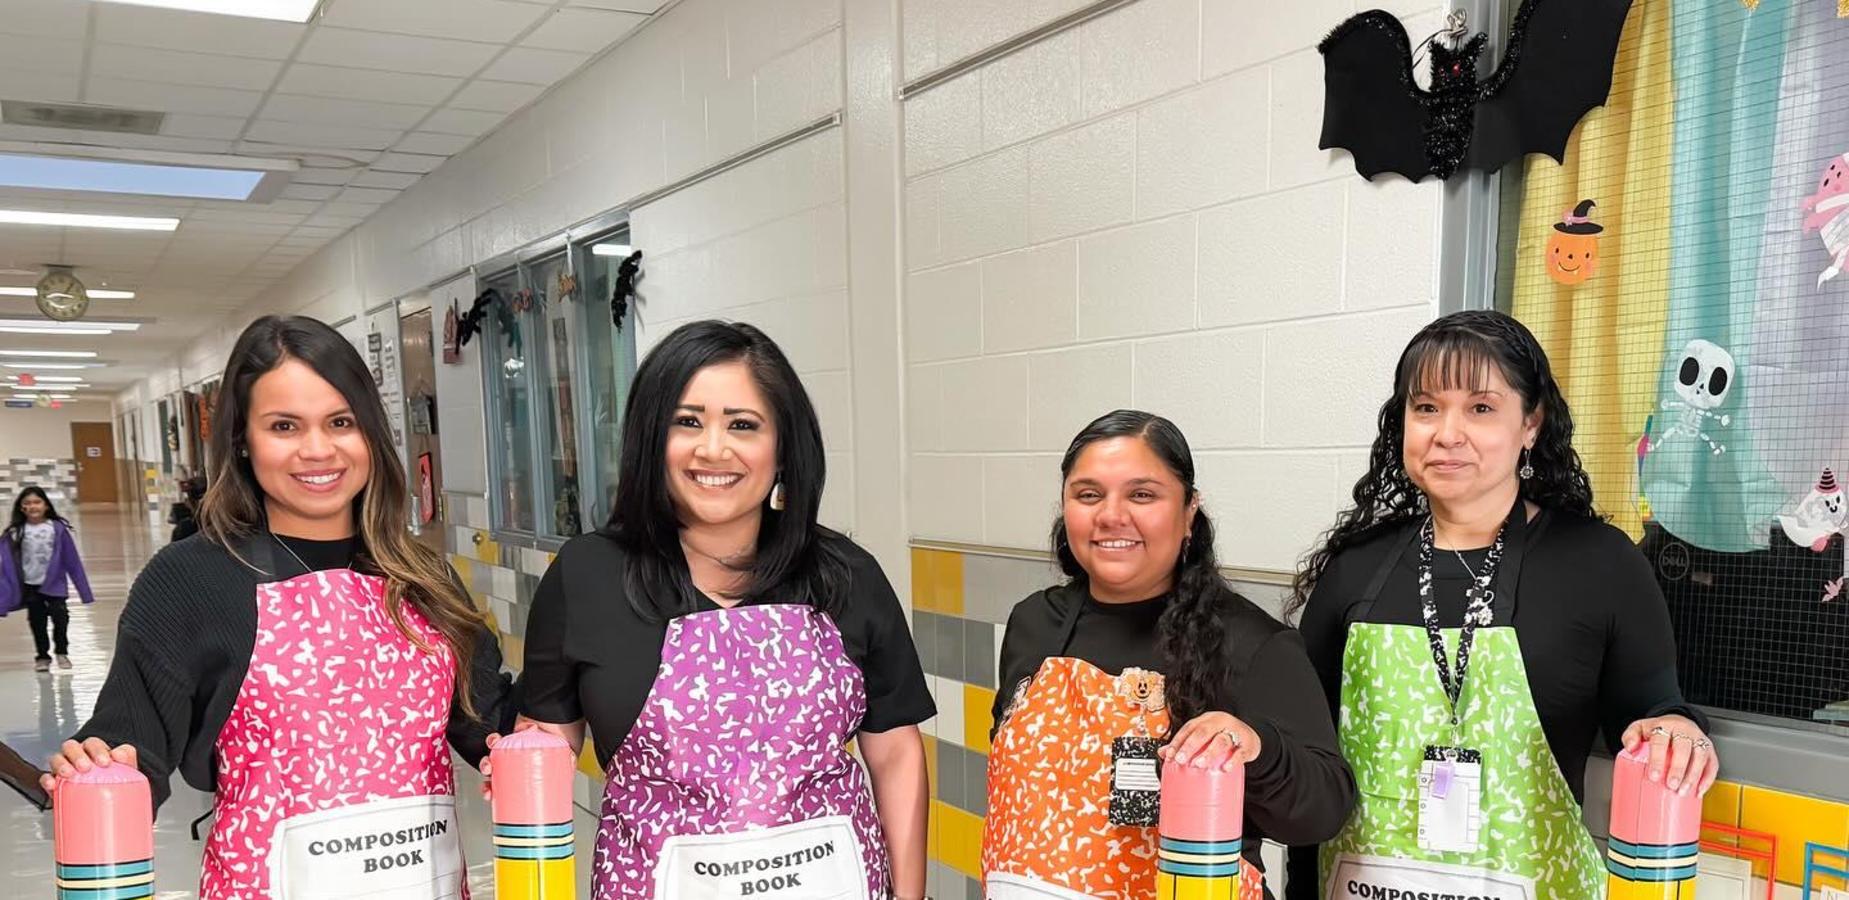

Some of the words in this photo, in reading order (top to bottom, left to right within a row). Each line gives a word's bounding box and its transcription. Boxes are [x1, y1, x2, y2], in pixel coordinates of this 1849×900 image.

[308, 819, 448, 856] COMPOSITION
[363, 849, 424, 873] BOOK
[694, 840, 835, 877] COMPOSITION
[740, 872, 802, 896] BOOK
[1347, 880, 1501, 900] COMPOS
